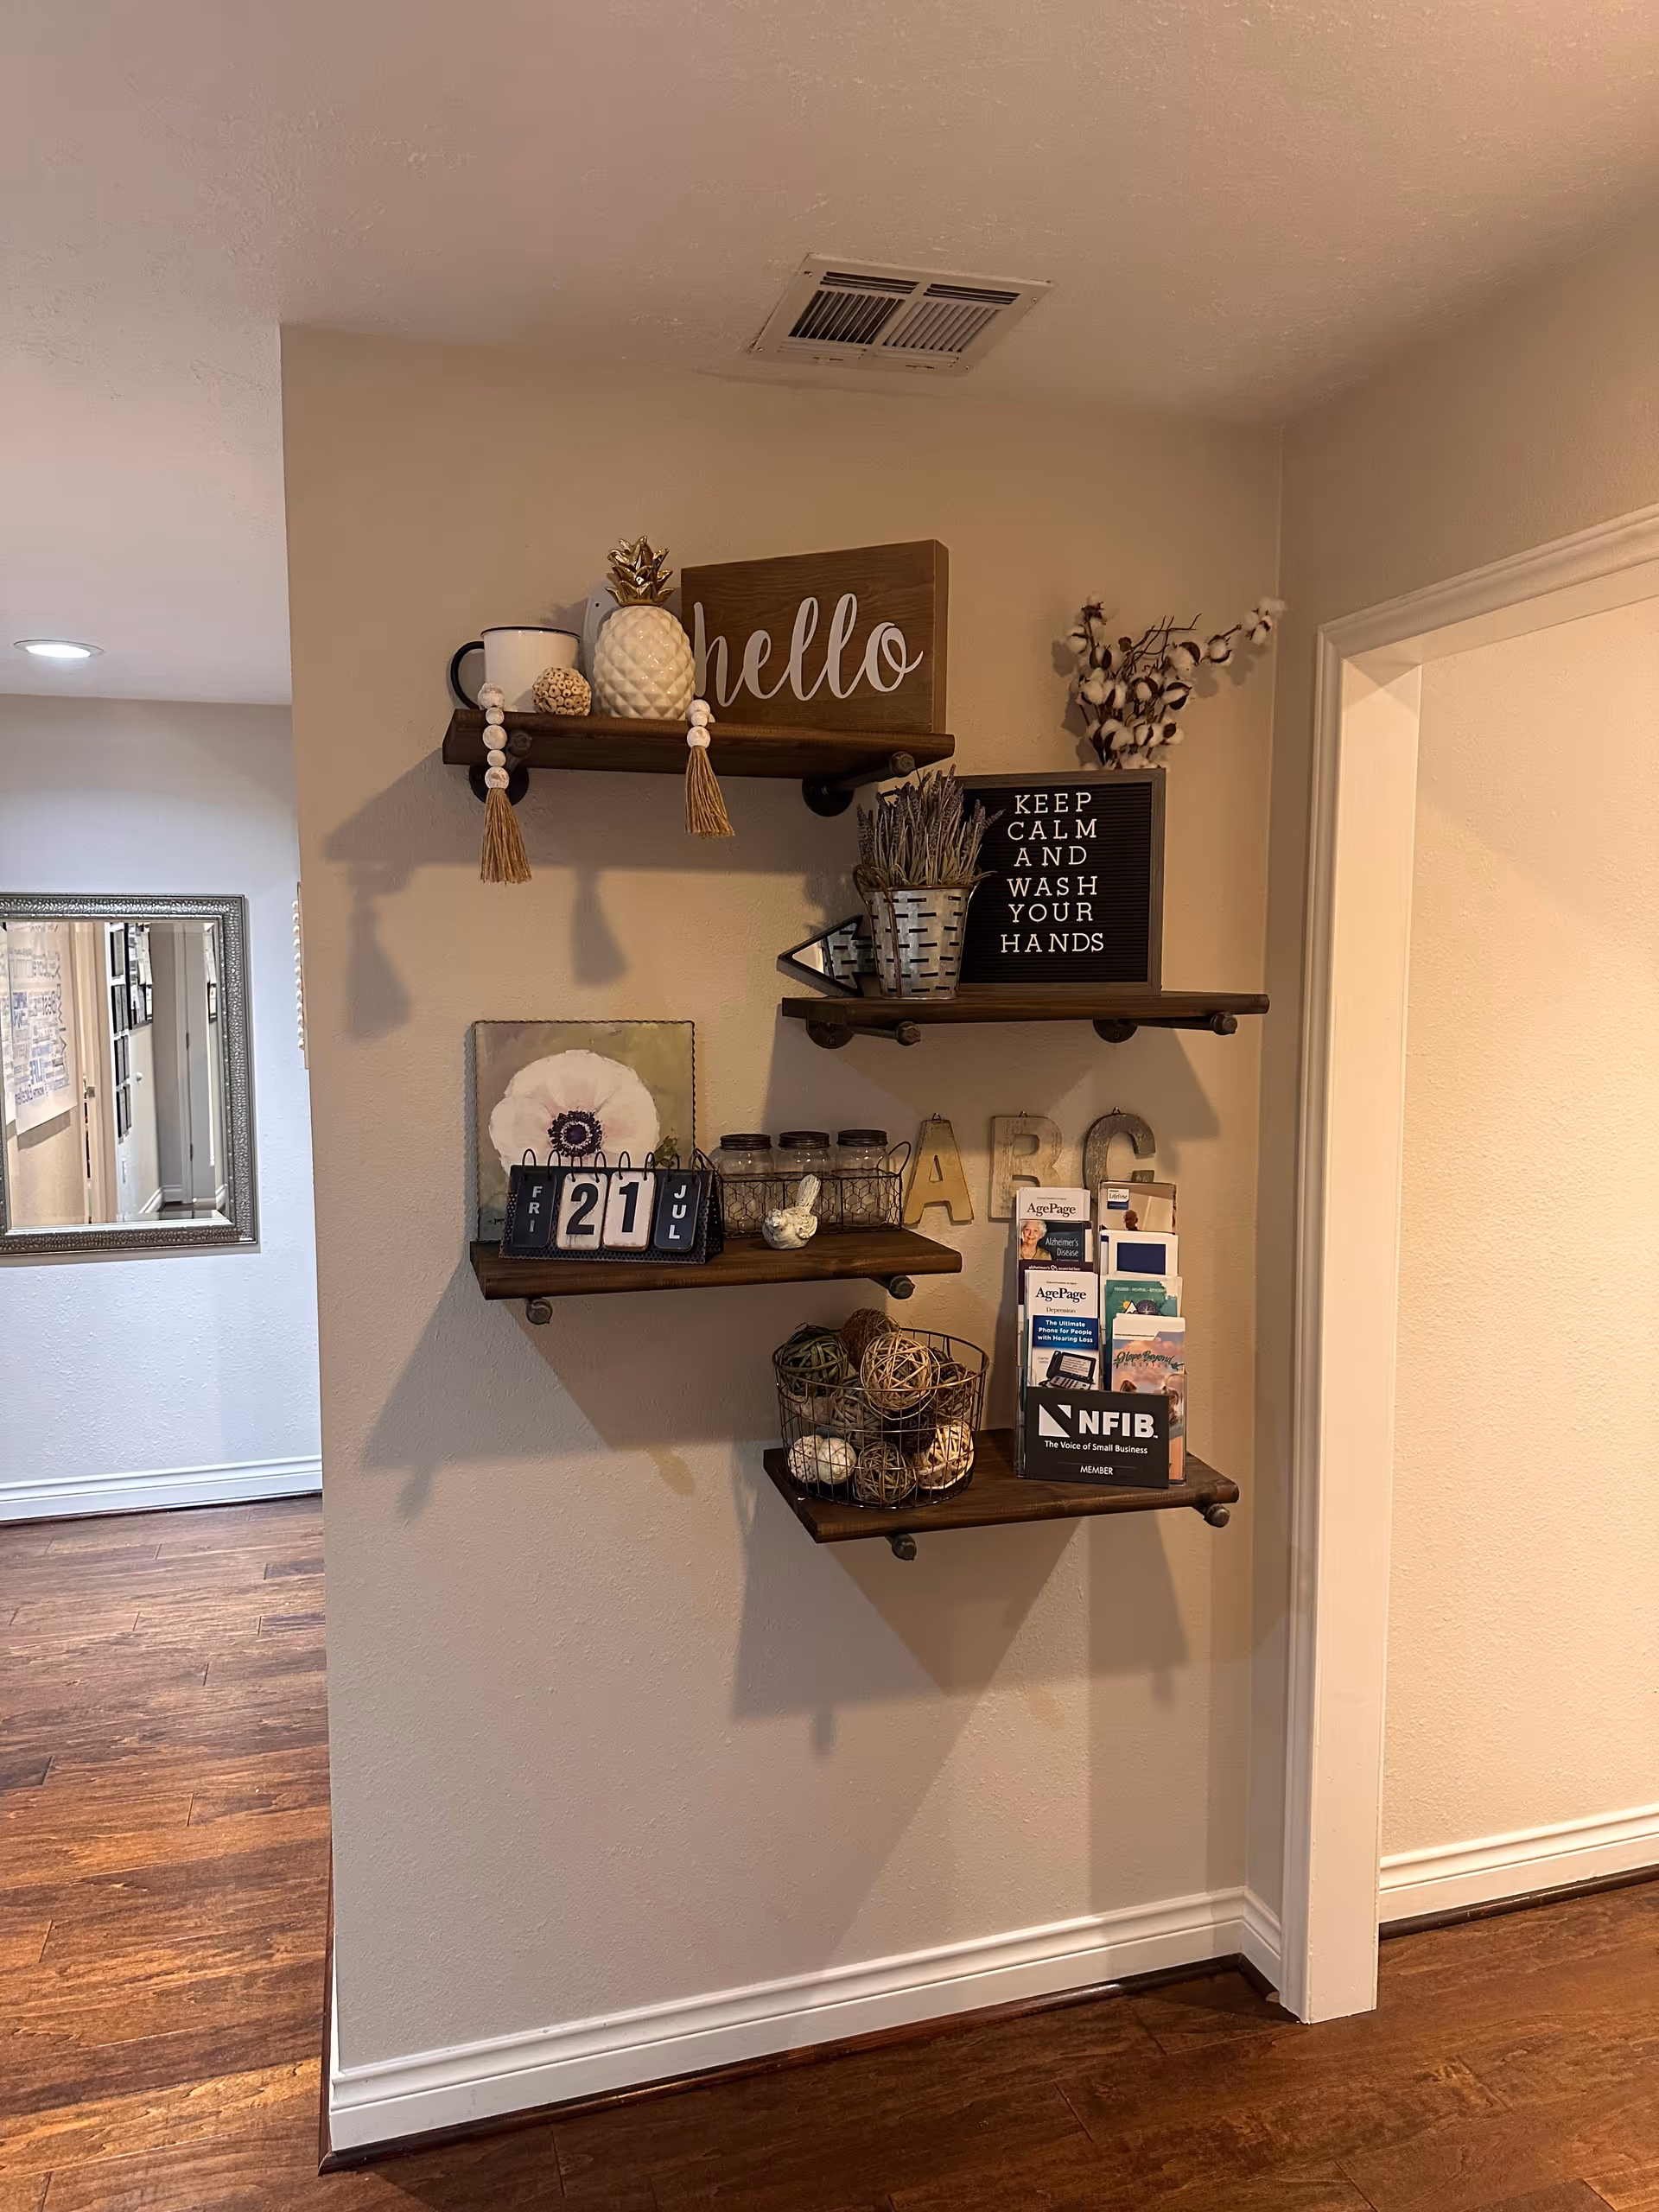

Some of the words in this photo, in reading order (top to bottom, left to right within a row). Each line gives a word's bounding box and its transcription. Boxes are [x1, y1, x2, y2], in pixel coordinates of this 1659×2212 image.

[692, 593, 924, 707] hello
[1014, 791, 1092, 814] KEEP
[1007, 818, 1097, 841] CALM
[1014, 846, 1087, 867] AND
[1007, 875, 1098, 897] WASH
[1007, 902, 1093, 923] YOUR
[1001, 932, 1104, 953] HANDS
[528, 1185, 543, 1232] FRI
[566, 1180, 639, 1236] 21
[668, 1185, 688, 1239] JUL
[1027, 1202, 1077, 1217] AgePage
[1045, 1237, 1079, 1247] Alzheimer's
[1057, 1248, 1079, 1257] Disease
[1035, 1287, 1087, 1303] AgePage
[1113, 1351, 1142, 1369] Hope
[1142, 1350, 1175, 1364] Beyond
[1079, 1409, 1154, 1439] NFIB
[1060, 1441, 1081, 1450] Voice
[1092, 1443, 1113, 1452] Small
[1115, 1445, 1148, 1454] Business
[1080, 1465, 1114, 1476] MEMBER
